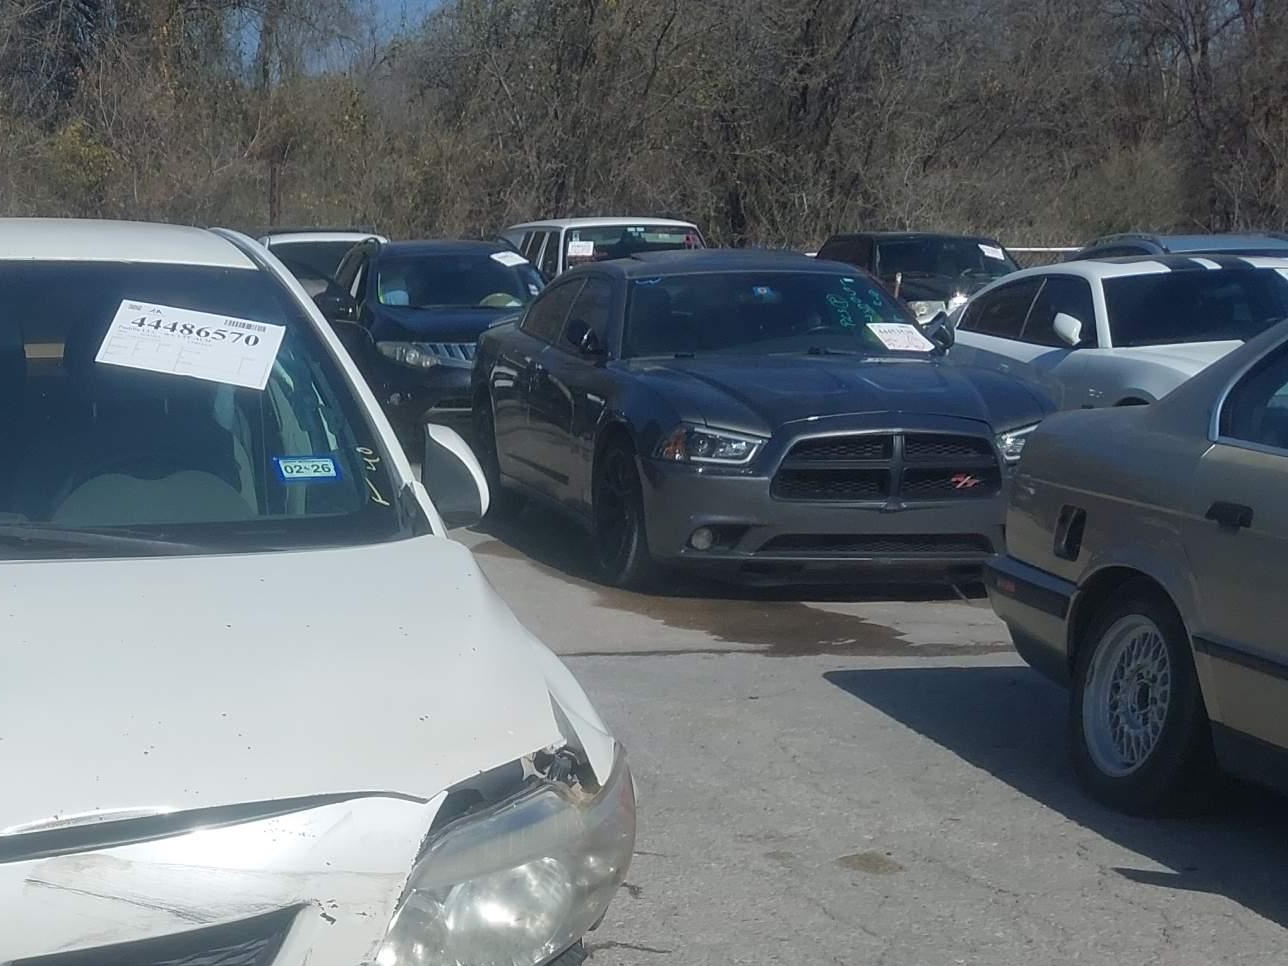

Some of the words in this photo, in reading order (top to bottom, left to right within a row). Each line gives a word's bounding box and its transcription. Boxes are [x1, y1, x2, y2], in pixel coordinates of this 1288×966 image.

[131, 316, 260, 347] 44486570
[284, 464, 305, 474] 02
[311, 464, 332, 473] 26
